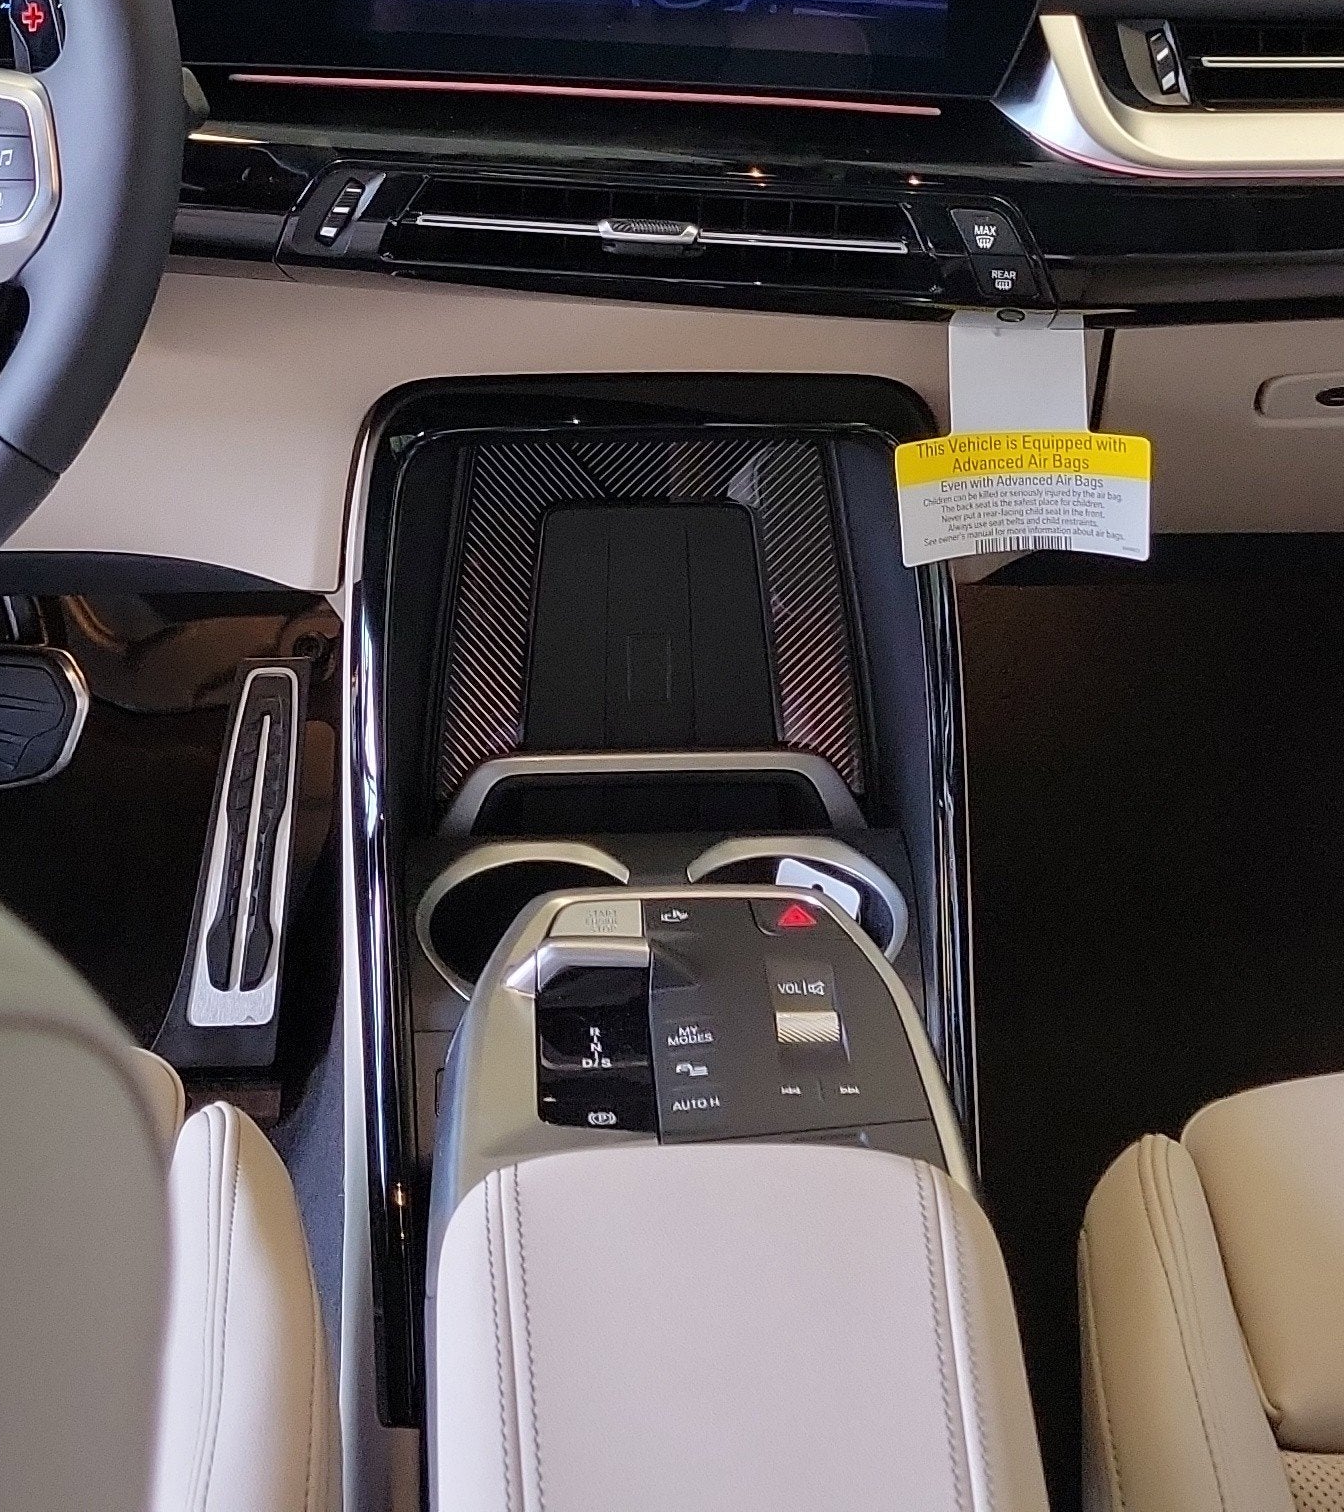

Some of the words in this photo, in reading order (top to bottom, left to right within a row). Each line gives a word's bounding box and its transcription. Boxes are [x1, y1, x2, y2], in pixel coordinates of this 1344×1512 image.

[974, 224, 997, 236] MAX
[991, 269, 1017, 280] REAR
[916, 441, 945, 458] This
[948, 435, 1002, 454] Vehicle
[1006, 435, 1017, 450] is
[1022, 434, 1093, 452] Equipped
[1096, 436, 1127, 453] with
[952, 454, 1024, 473] Advanced
[1028, 453, 1048, 469] Air
[1052, 453, 1090, 472] Bags
[940, 480, 968, 493] Even
[969, 476, 994, 488] with
[996, 475, 1053, 487] Advanced
[1056, 474, 1072, 486] Air
[1075, 475, 1104, 490] Bags
[923, 495, 953, 507] Children
[953, 494, 967, 502] can
[967, 492, 978, 500] be
[978, 490, 998, 499] killed
[1009, 489, 1043, 498] seriously
[1045, 489, 1071, 498] injured
[1072, 489, 1081, 498] by
[1083, 490, 1095, 499] the
[1097, 491, 1106, 499] air
[941, 505, 955, 513] The
[956, 502, 973, 511] back
[975, 501, 991, 509] seat
[1000, 499, 1012, 507] the
[1013, 498, 1037, 507] safest
[1038, 498, 1058, 507] place
[1060, 498, 1070, 506] for
[941, 514, 962, 523] Never
[963, 512, 976, 521] put
[983, 508, 1024, 518] rear-facing
[1025, 507, 1044, 515] child
[1045, 508, 1061, 516] seat
[1062, 508, 1070, 516] in
[948, 523, 973, 532] Always
[988, 519, 1004, 527] seat
[1006, 517, 1025, 526] belts
[1026, 517, 1040, 525] and
[1041, 517, 1060, 525] child
[923, 537, 937, 547] See
[966, 528, 994, 538] manual
[1006, 527, 1027, 535] more
[1027, 526, 1072, 535] information
[1072, 528, 1094, 537] about
[1095, 529, 1105, 537] air
[777, 982, 802, 995] VOL
[589, 1026, 601, 1037] R
[678, 1025, 698, 1036] MY
[590, 1042, 602, 1053] N
[667, 1033, 714, 1047] MODES
[672, 1097, 707, 1112] AUTO
[709, 1095, 720, 1108] H
